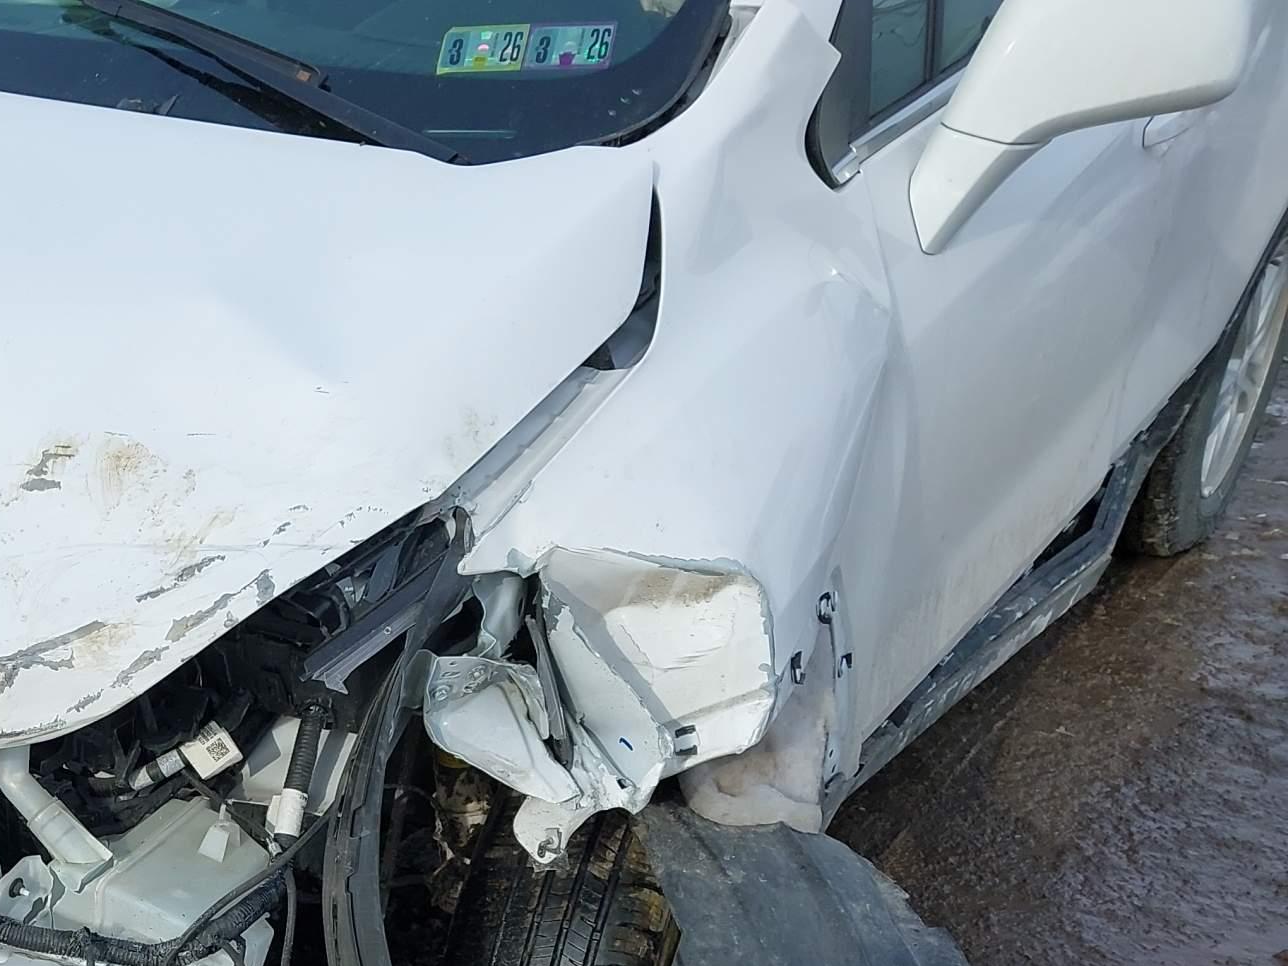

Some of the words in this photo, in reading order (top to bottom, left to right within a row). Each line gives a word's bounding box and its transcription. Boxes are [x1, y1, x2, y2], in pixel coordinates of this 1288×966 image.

[448, 39, 464, 67] 3
[499, 31, 524, 62] 26
[535, 36, 551, 63] 3
[586, 28, 612, 60] 26
